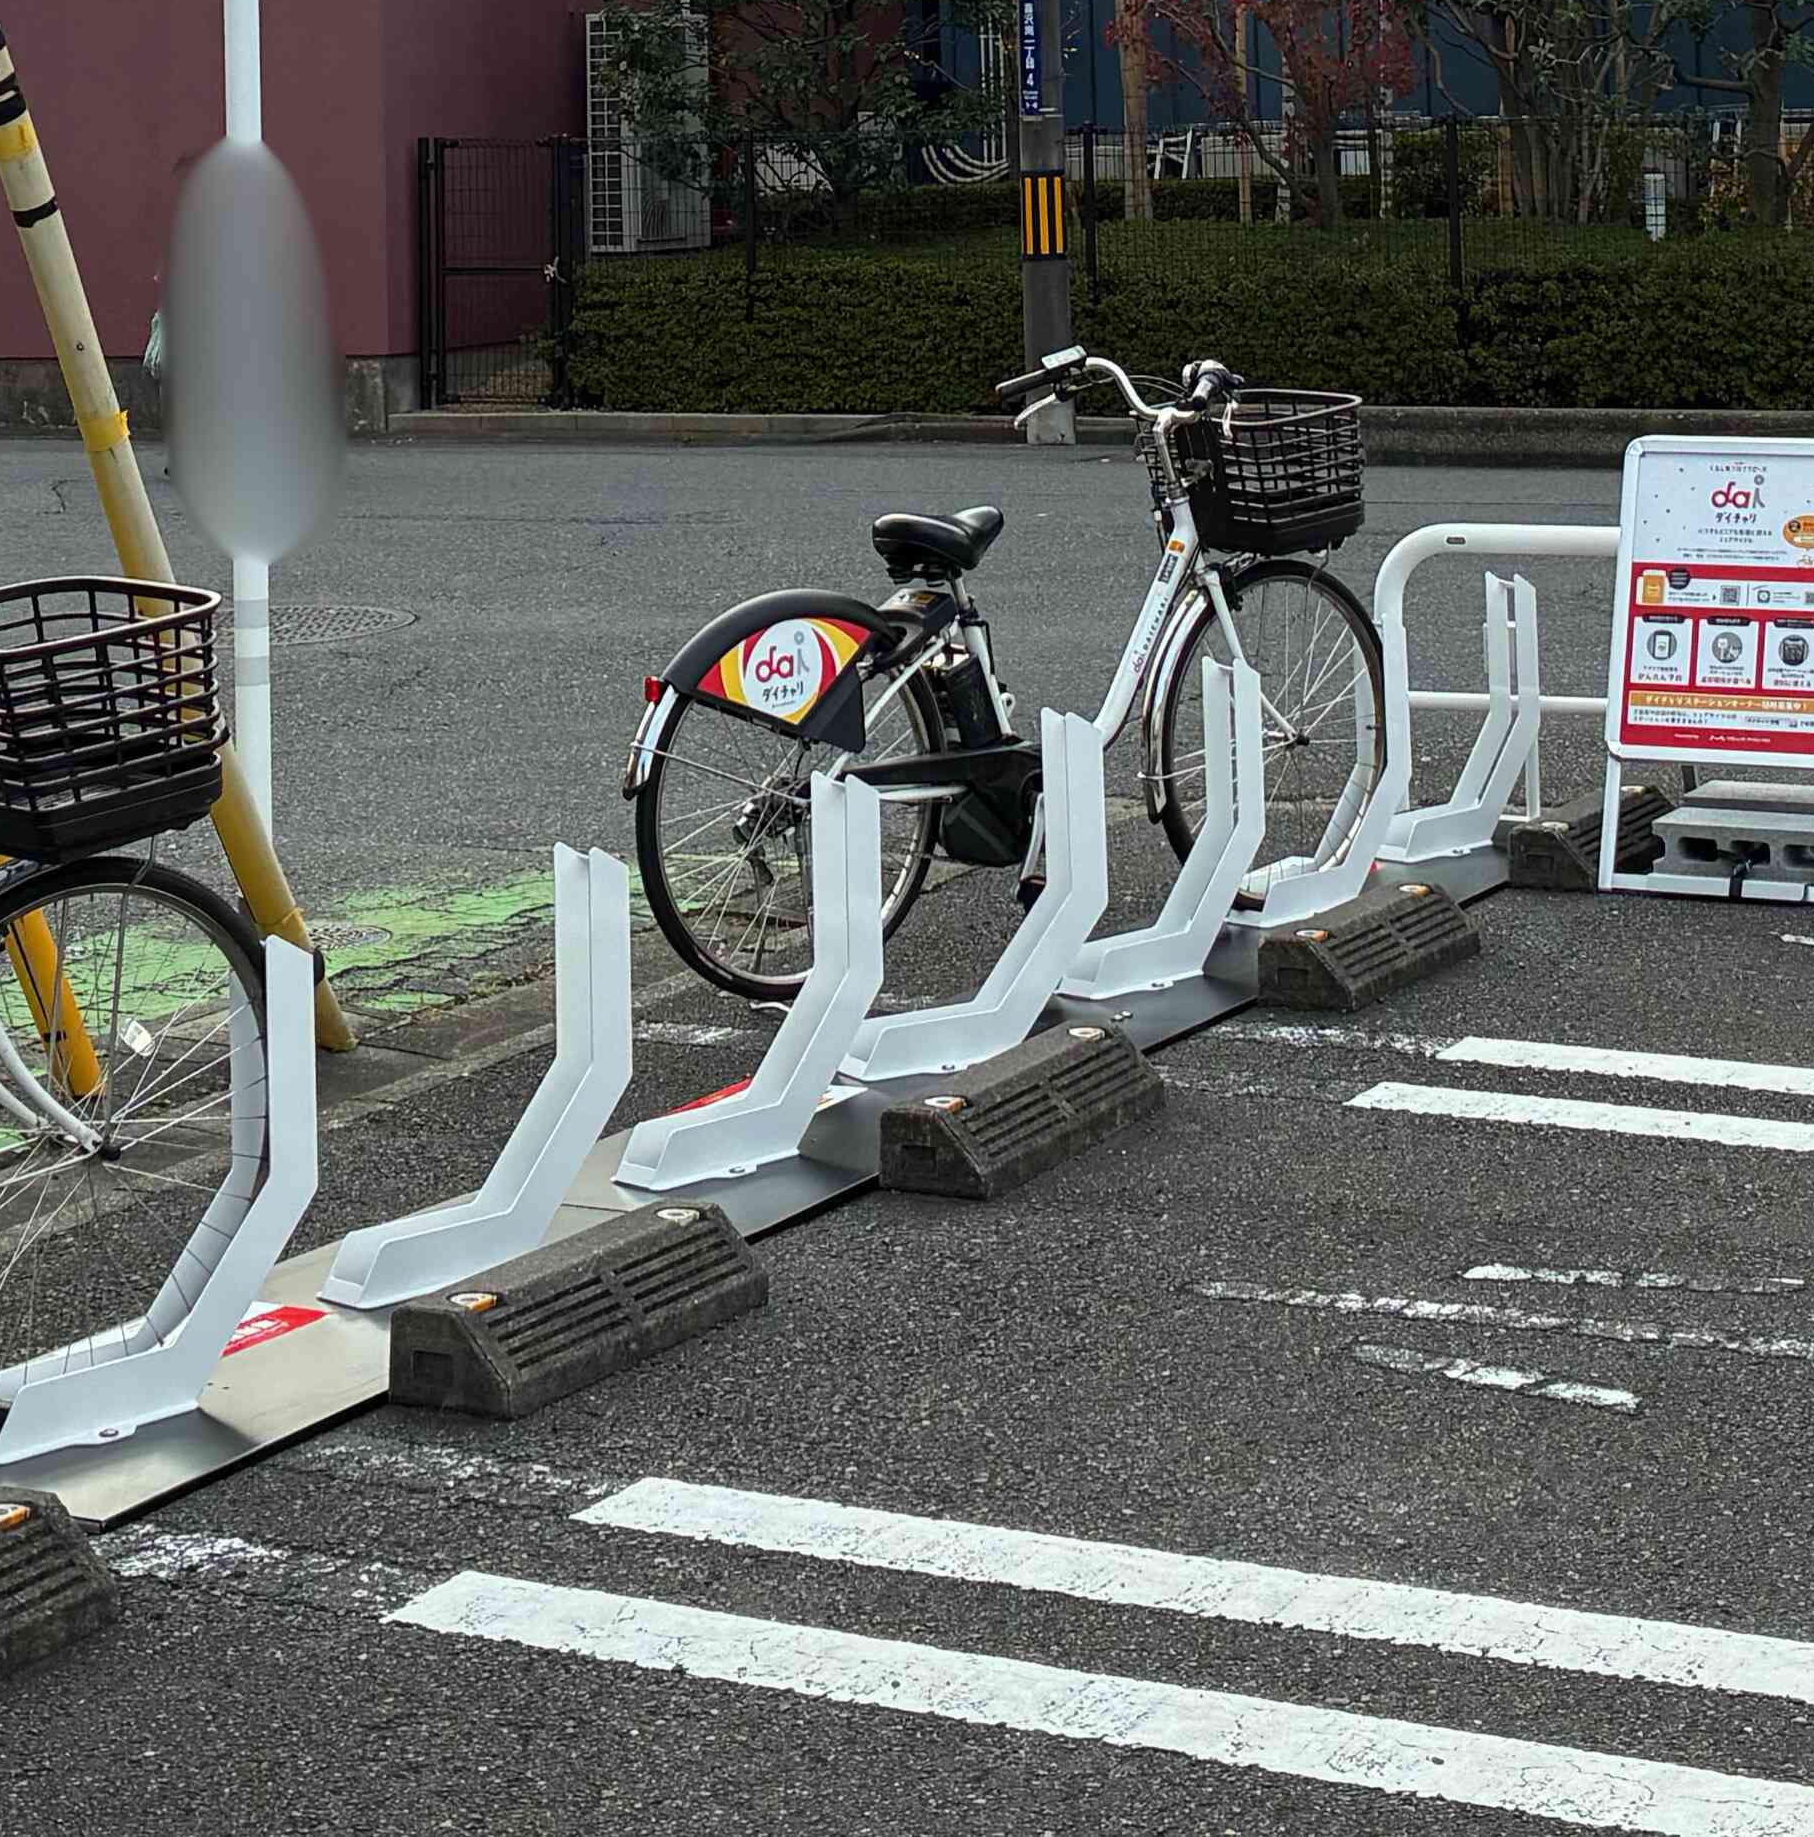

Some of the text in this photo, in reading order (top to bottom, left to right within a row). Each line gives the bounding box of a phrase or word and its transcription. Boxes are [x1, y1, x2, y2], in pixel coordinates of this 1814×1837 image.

[1711, 474, 1766, 509] dai
[1716, 512, 1758, 524] ダイチャリ
[755, 630, 811, 683] dai
[762, 680, 805, 702] ダイチャリ
